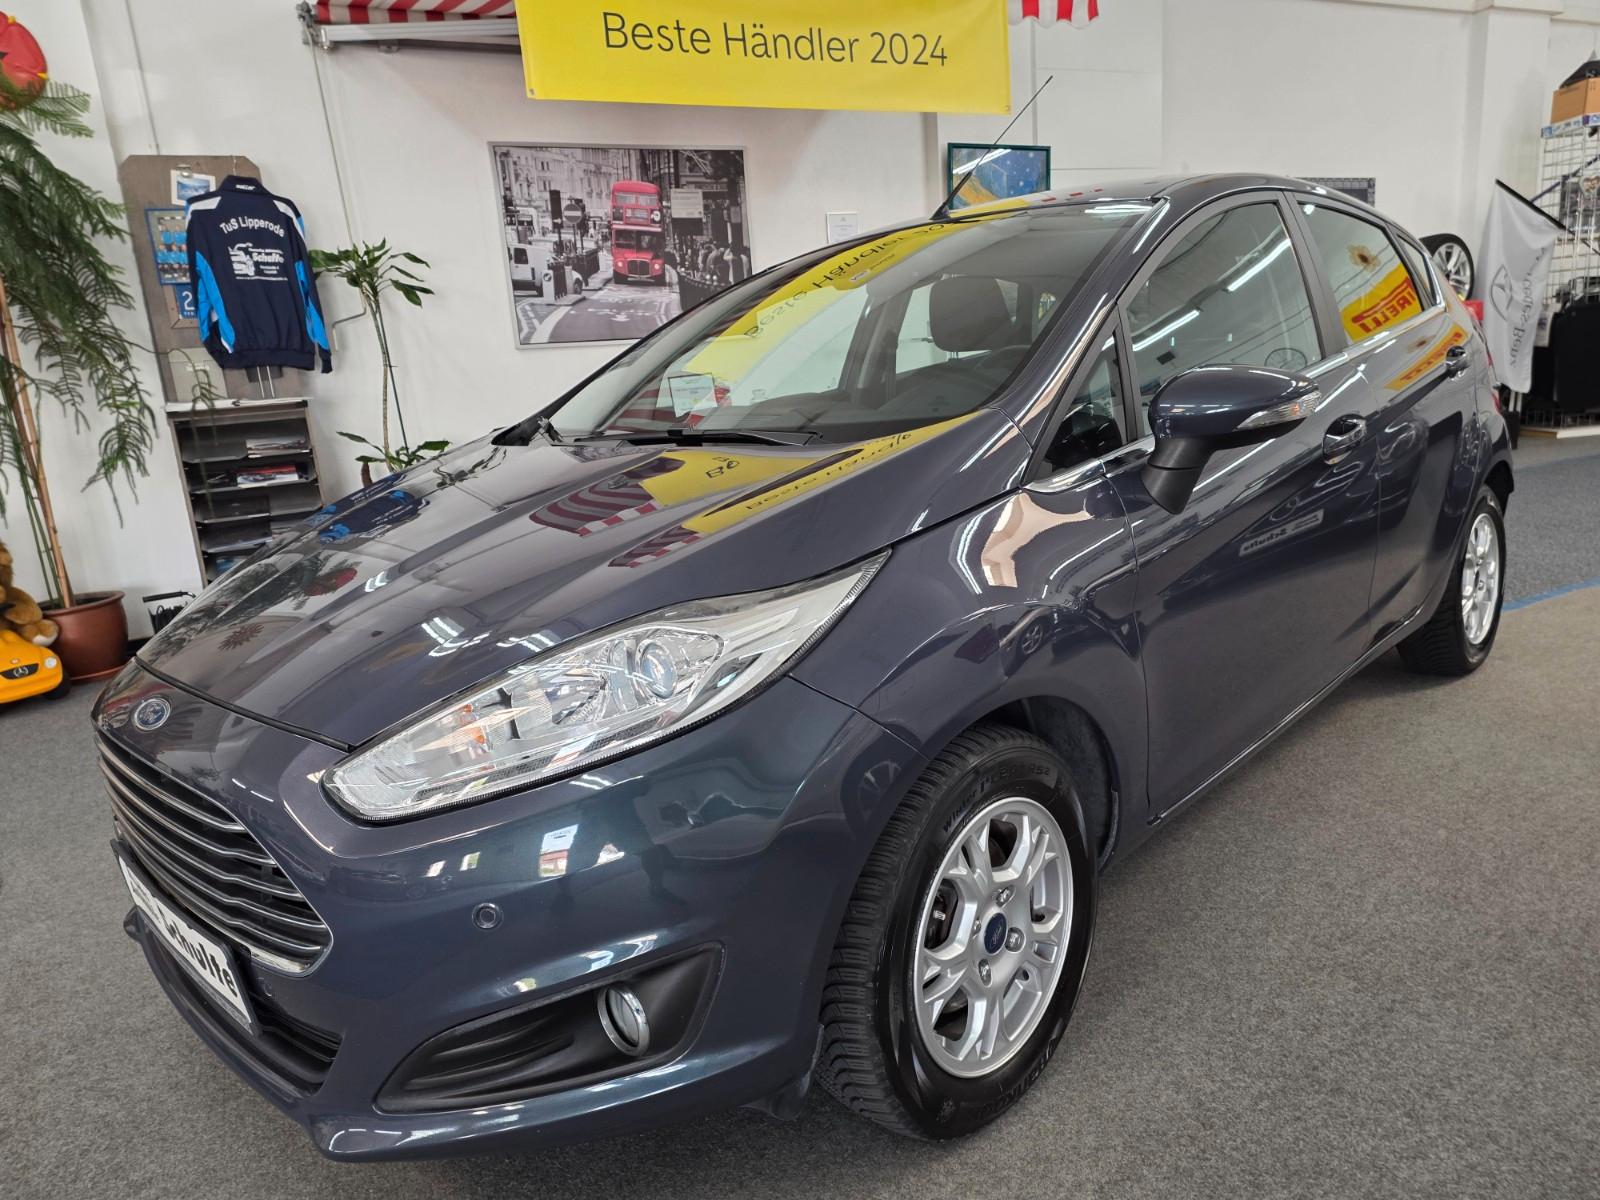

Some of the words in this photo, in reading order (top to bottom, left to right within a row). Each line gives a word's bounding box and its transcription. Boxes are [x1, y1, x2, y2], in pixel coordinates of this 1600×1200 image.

[602, 11, 711, 55] Beste
[725, 22, 860, 64] Händler
[870, 32, 948, 67] 2024
[220, 218, 239, 234] TuS
